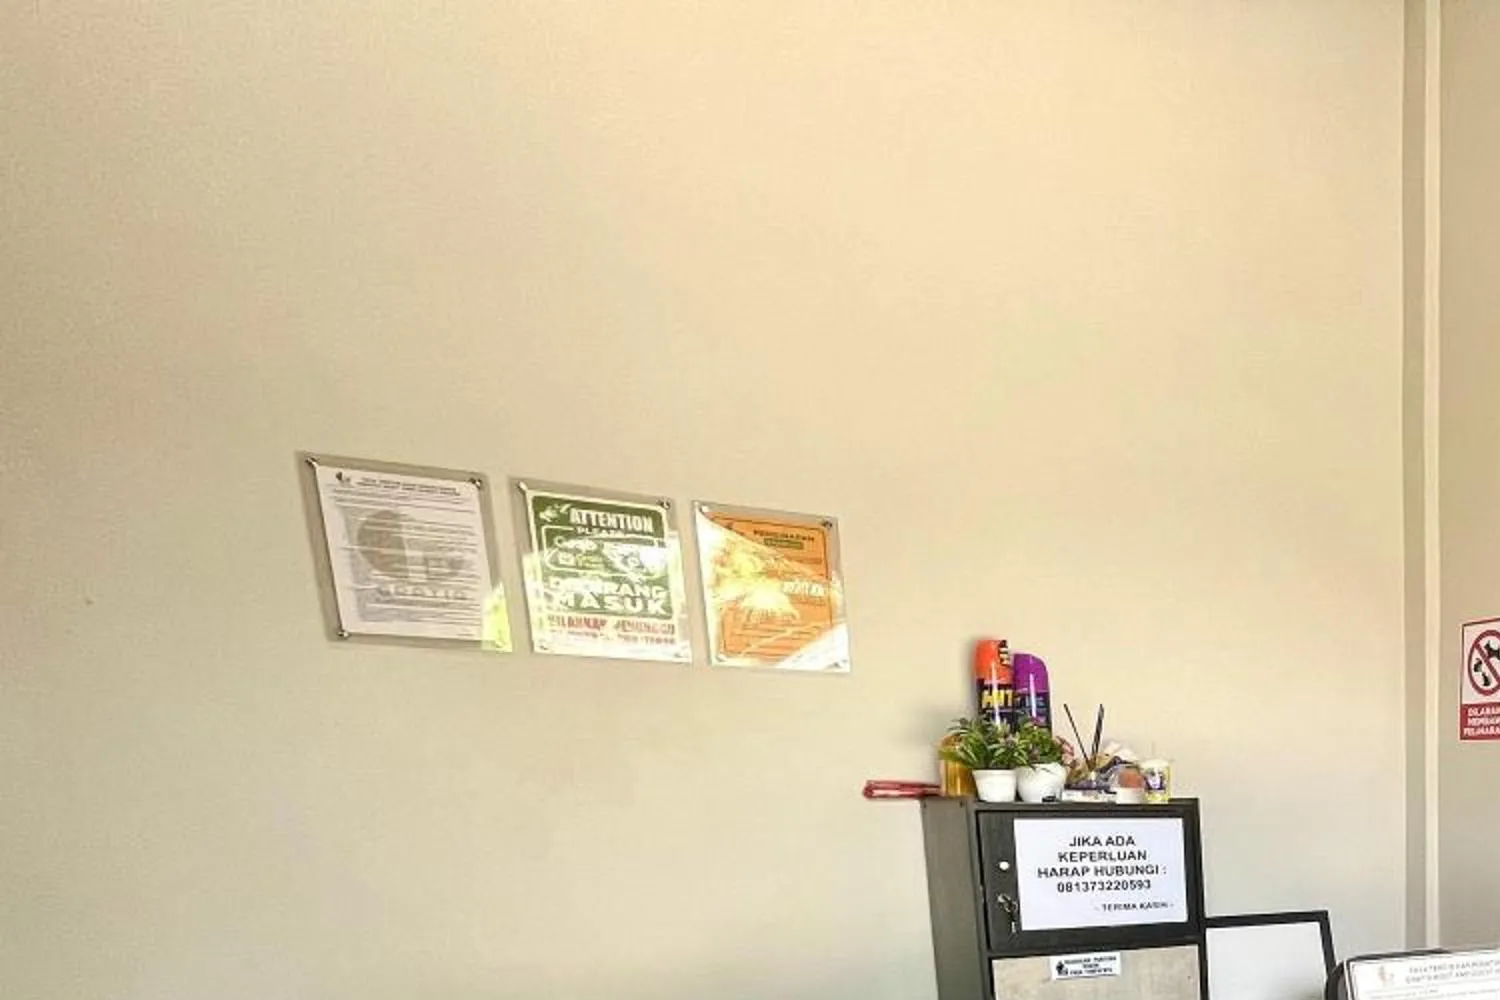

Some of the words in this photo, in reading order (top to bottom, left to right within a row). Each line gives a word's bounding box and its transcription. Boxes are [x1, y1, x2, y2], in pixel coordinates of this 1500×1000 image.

[570, 508, 653, 532] ATTENTION
[1069, 836, 1102, 847] JIKA
[1105, 835, 1136, 846] ADA
[1058, 850, 1147, 862] KEPERLUAN
[1037, 867, 1090, 878] HARAP
[1093, 864, 1160, 877] HUBUNGI
[1057, 879, 1152, 893] 081373220593
[1102, 903, 1137, 912] TERIMA
